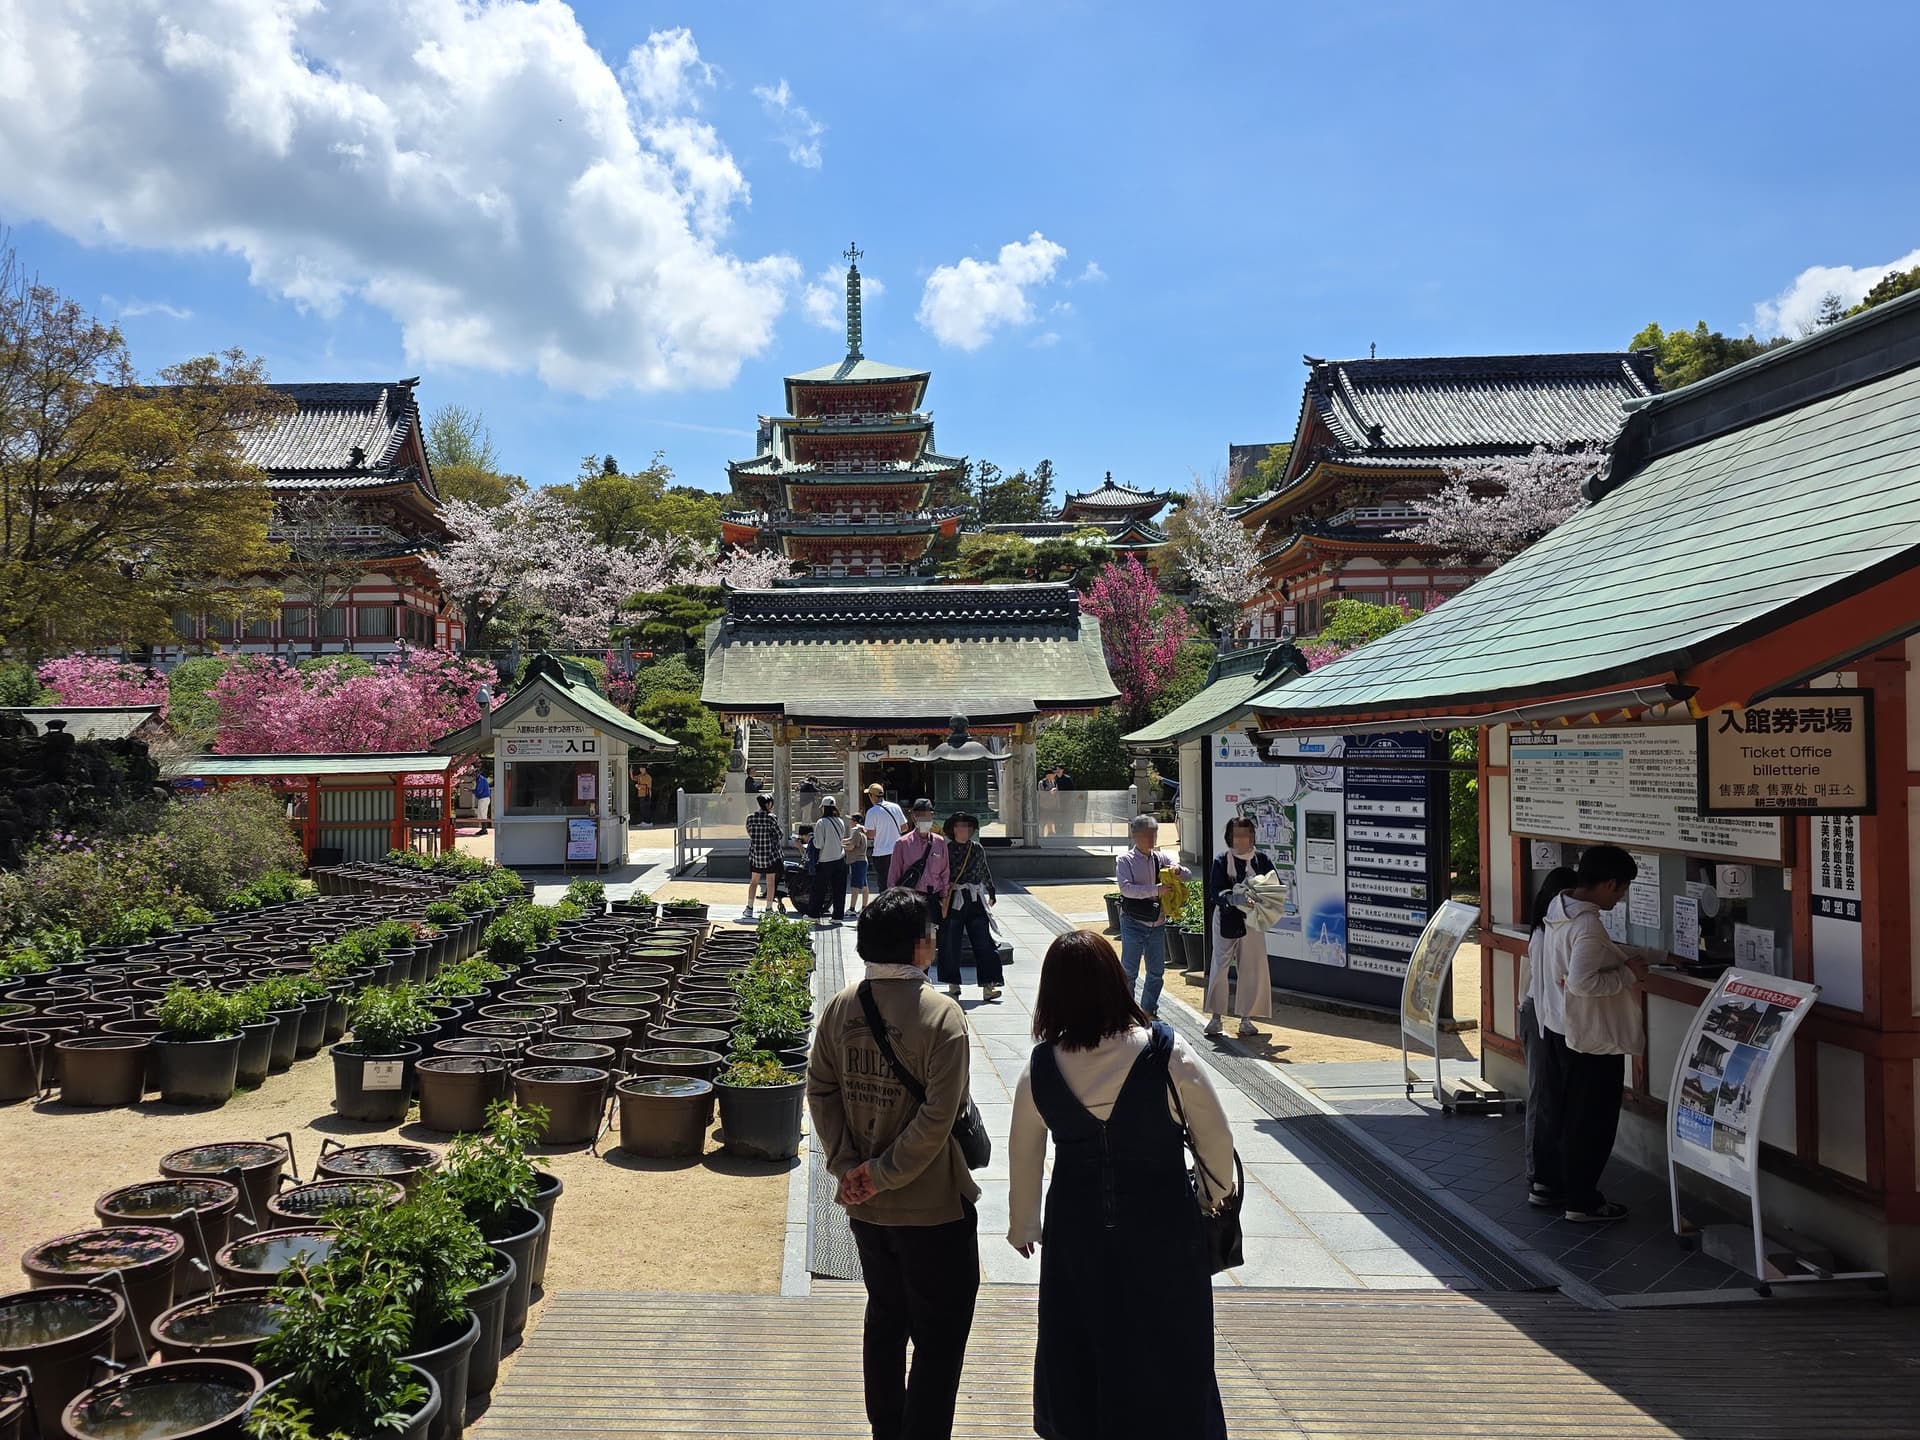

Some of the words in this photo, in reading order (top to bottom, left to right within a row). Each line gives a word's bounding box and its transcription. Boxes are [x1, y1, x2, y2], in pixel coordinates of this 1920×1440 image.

[1718, 707, 1852, 734] 入館券売場
[565, 740, 595, 754] 入口
[1234, 748, 1280, 757] 耕三寺館
[1740, 746, 1786, 759] Ticket
[1790, 746, 1832, 759] Office
[1753, 763, 1820, 777] billetterie
[1718, 783, 1760, 797] 售票處
[1767, 783, 1808, 797] 售票处
[1814, 783, 1856, 798] 매표소
[1755, 797, 1818, 808] 耕三寺博物館
[1541, 847, 1549, 859] 2
[1729, 871, 1739, 885] 1
[1821, 898, 1857, 917] 加盟館
